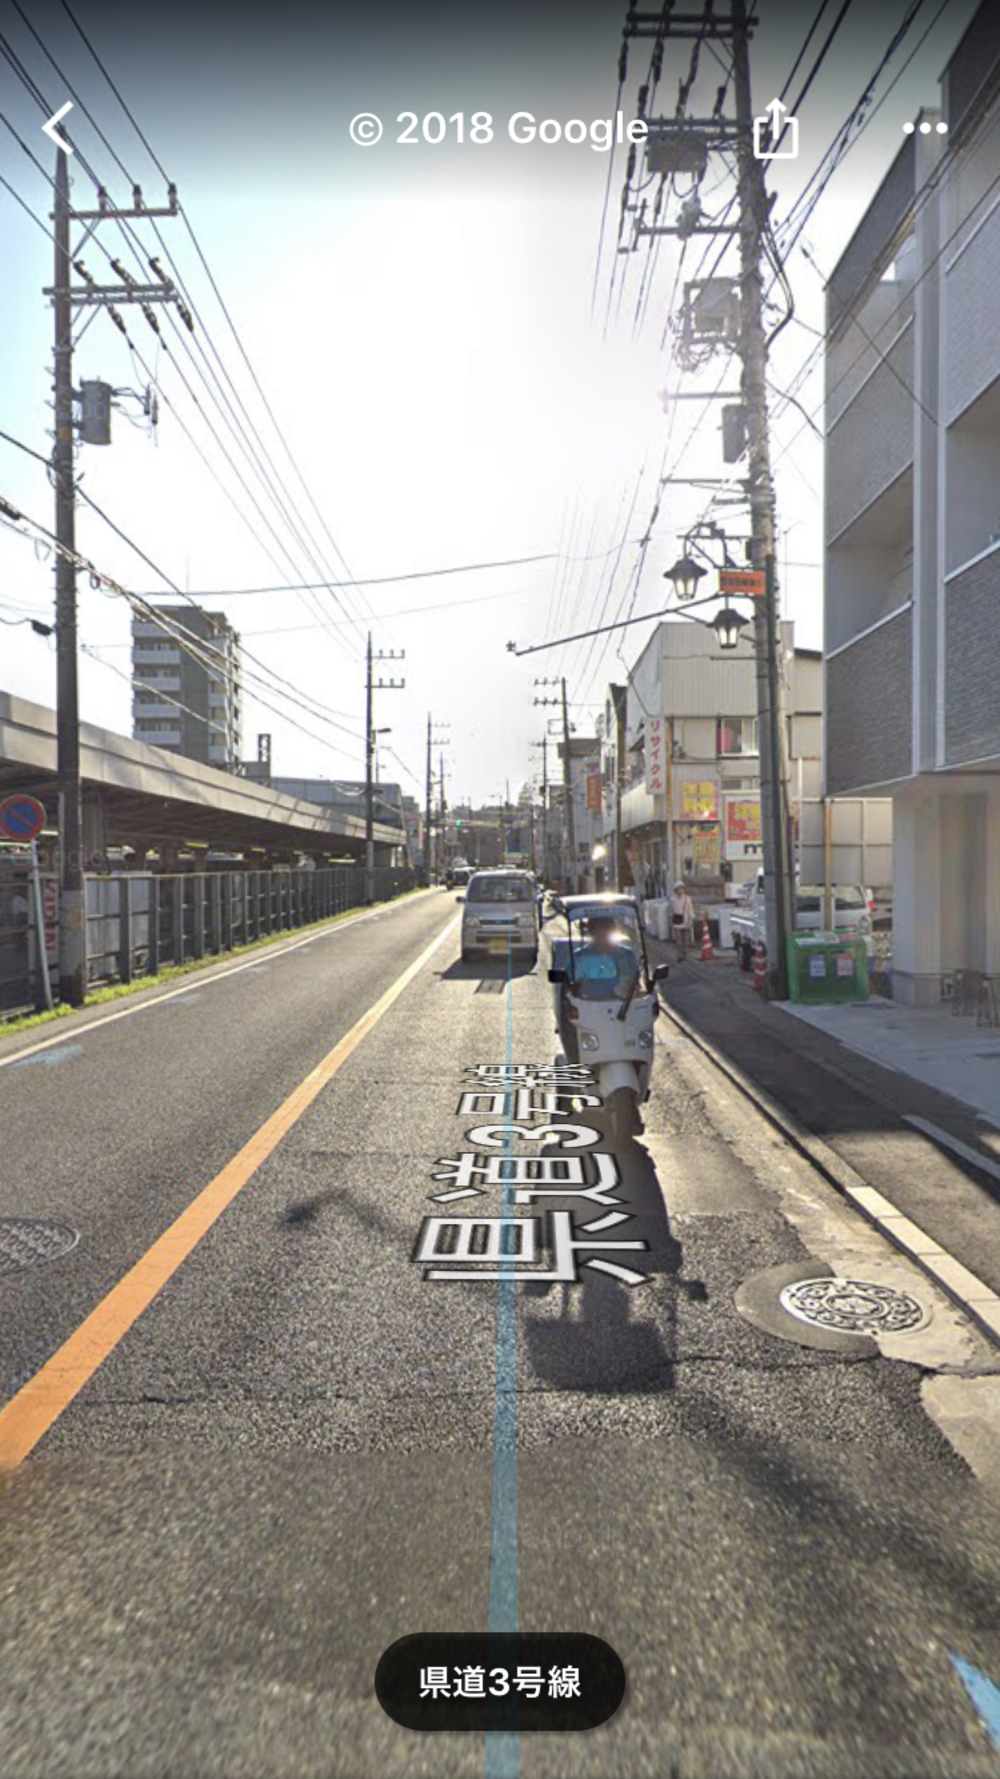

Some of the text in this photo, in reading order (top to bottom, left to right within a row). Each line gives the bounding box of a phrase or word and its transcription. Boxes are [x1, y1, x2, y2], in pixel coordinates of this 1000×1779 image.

[650, 720, 663, 791] リサイクル
